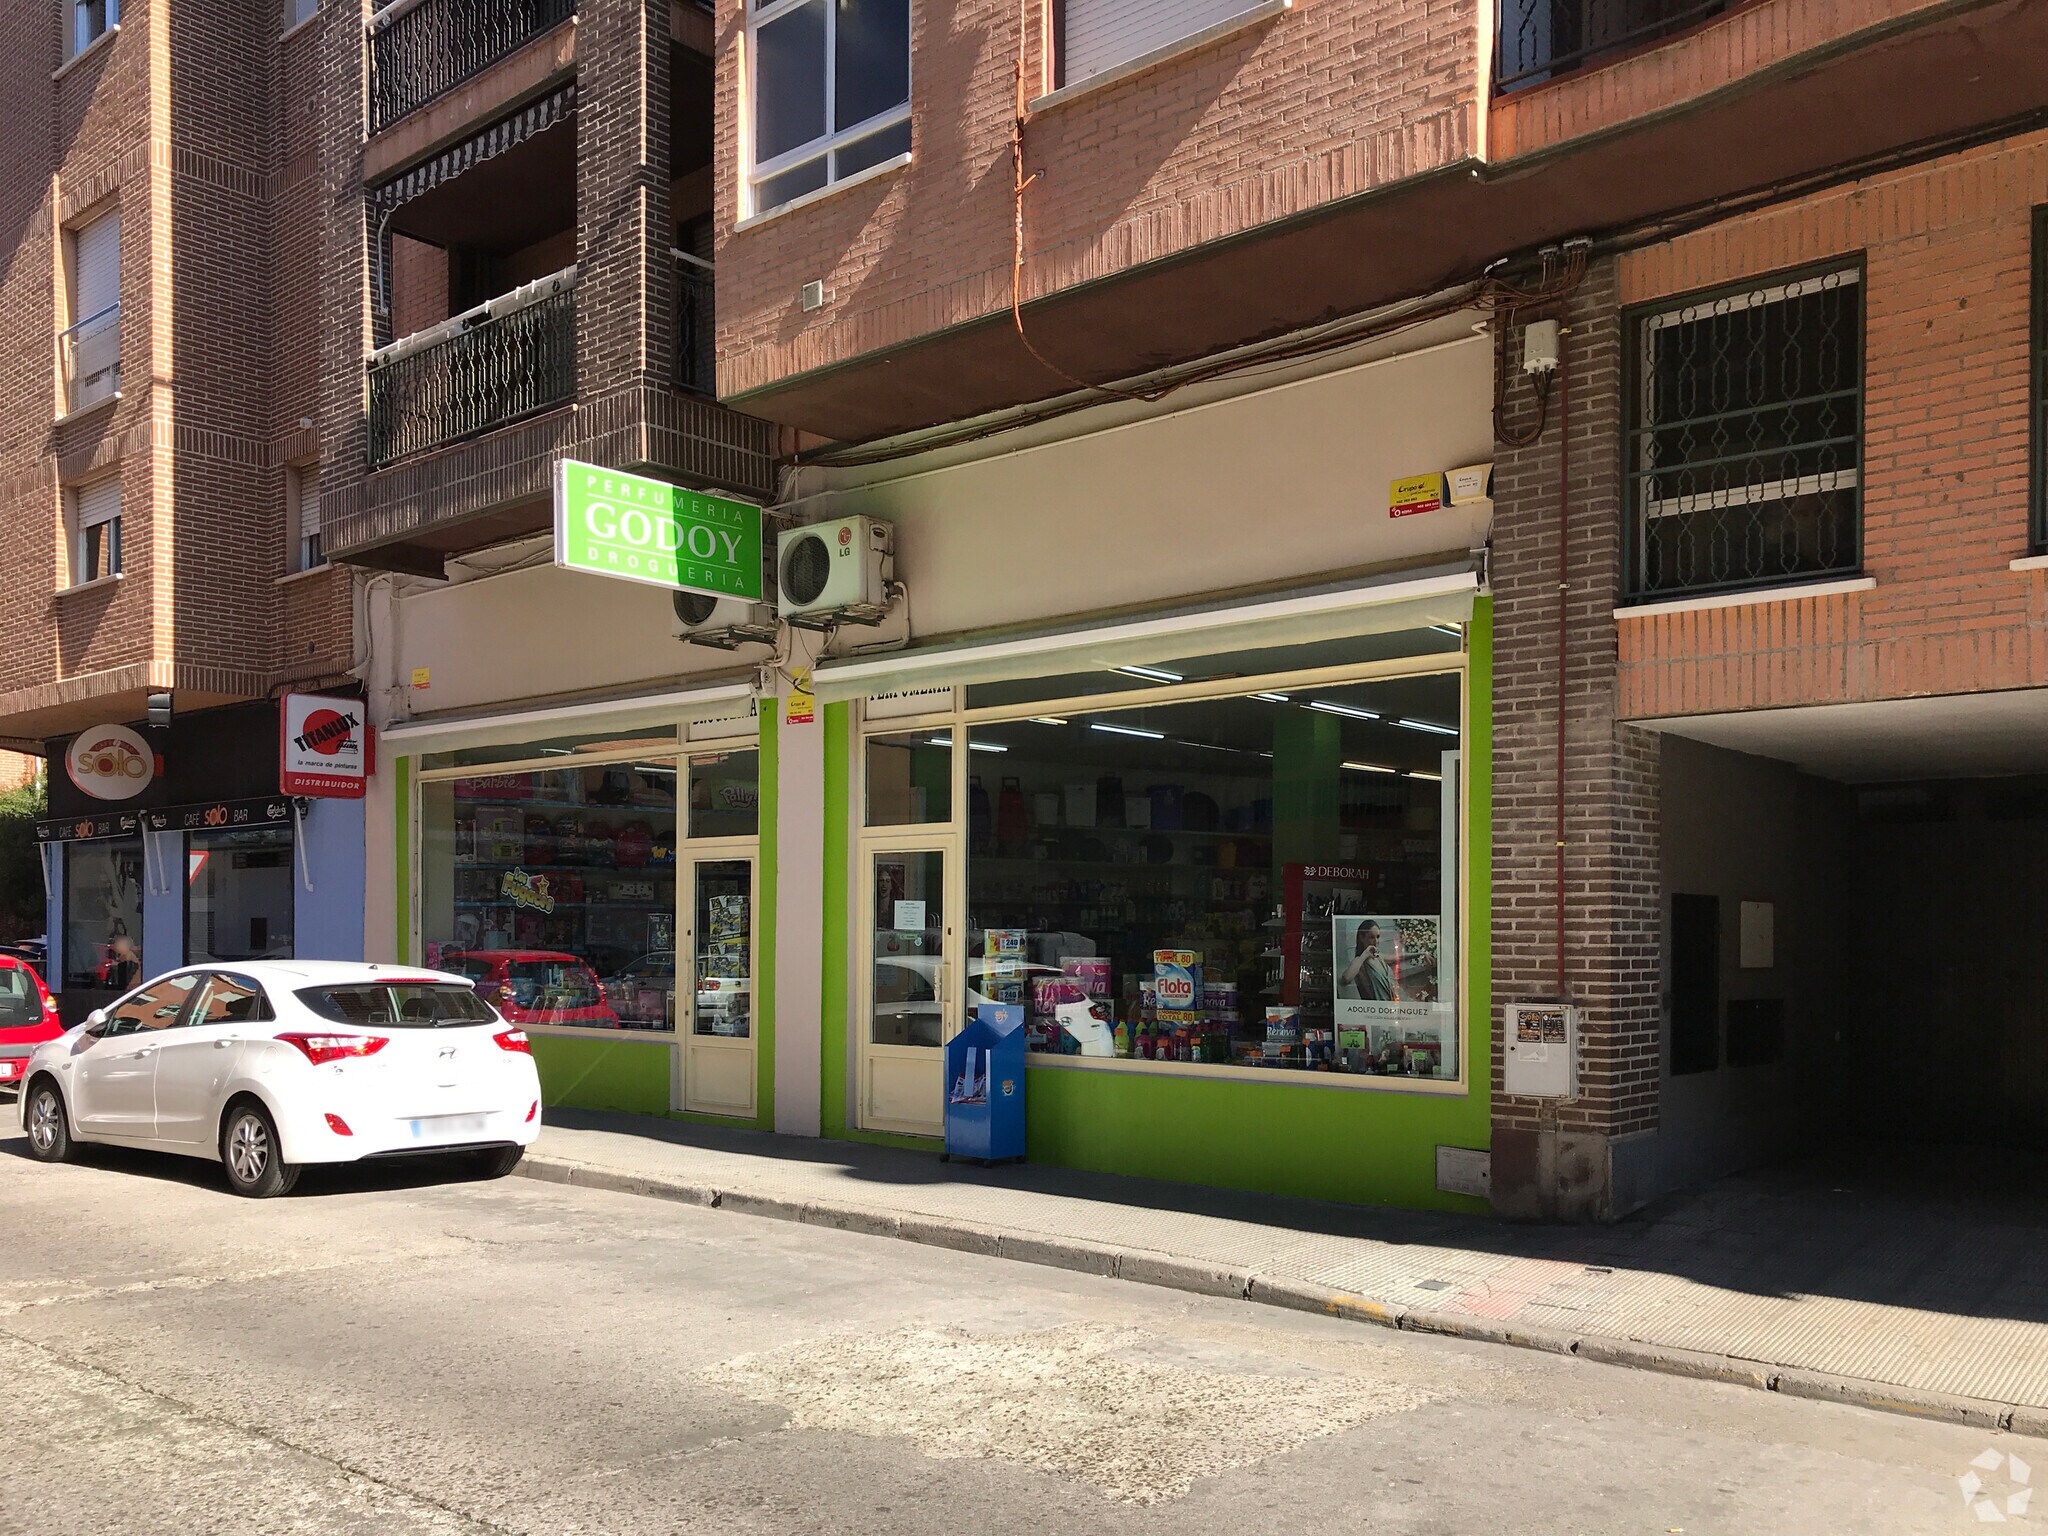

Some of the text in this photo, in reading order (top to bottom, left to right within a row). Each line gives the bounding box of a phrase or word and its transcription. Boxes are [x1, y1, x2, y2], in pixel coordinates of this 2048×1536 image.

[586, 475, 744, 523] PERFUMERIA
[585, 501, 743, 564] GODOY
[839, 547, 851, 557] LG
[587, 547, 744, 589] DROGUERIA
[293, 712, 360, 752] TITANLUX
[294, 778, 360, 790] DISTRIBUIDOR
[466, 774, 521, 791] Barbie
[233, 809, 248, 822] BAR
[1318, 866, 1370, 879] DEBORAH
[1005, 939, 1019, 947] 240
[1180, 954, 1191, 963] 80
[1157, 978, 1192, 994] Flota
[1182, 1012, 1193, 1021] 80
[1347, 1006, 1376, 1014] ADOLFO
[1267, 1026, 1296, 1038] Renova
